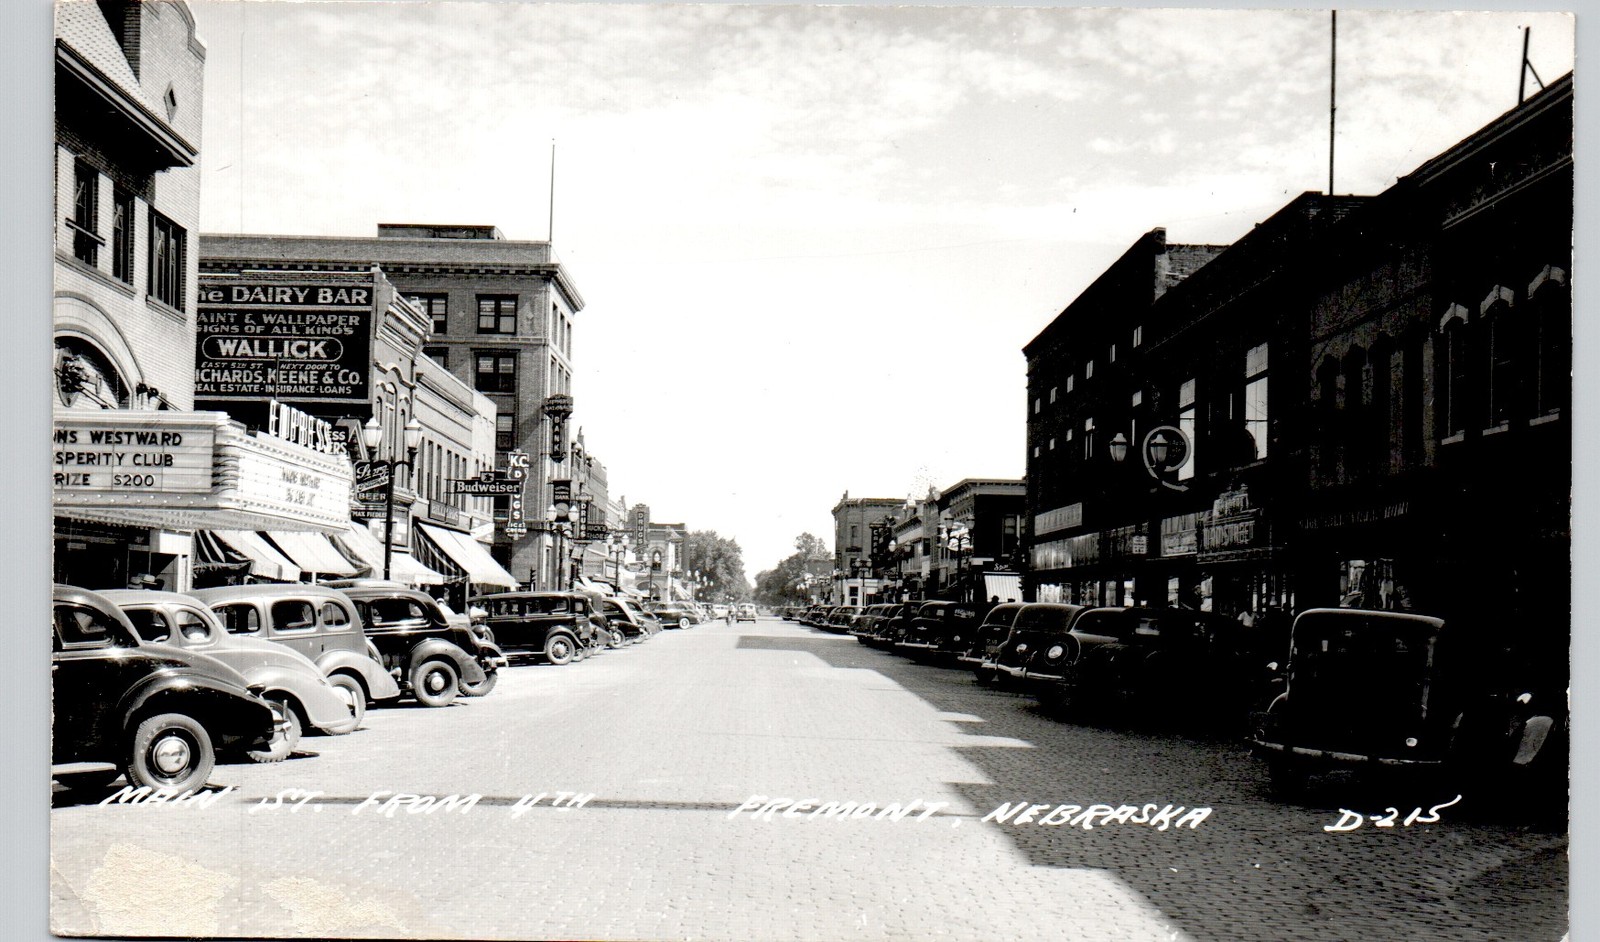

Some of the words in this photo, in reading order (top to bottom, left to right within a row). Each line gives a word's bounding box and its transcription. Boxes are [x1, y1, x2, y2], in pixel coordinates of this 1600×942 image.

[232, 286, 310, 303] DAIRY
[317, 288, 368, 304] BAR
[198, 313, 237, 323] AINT
[244, 313, 256, 325] &
[262, 313, 360, 326] WALLPAPER
[244, 326, 266, 334] OF
[271, 326, 300, 334] ALL
[217, 339, 327, 358] WALLICK
[267, 368, 318, 384] KEENE
[322, 371, 334, 384] &
[269, 399, 332, 454] EMPRESS
[90, 431, 182, 446] WESTWARD
[56, 452, 125, 466] SPERITY
[133, 453, 174, 467] CLUB
[455, 480, 519, 492] Budweiser
